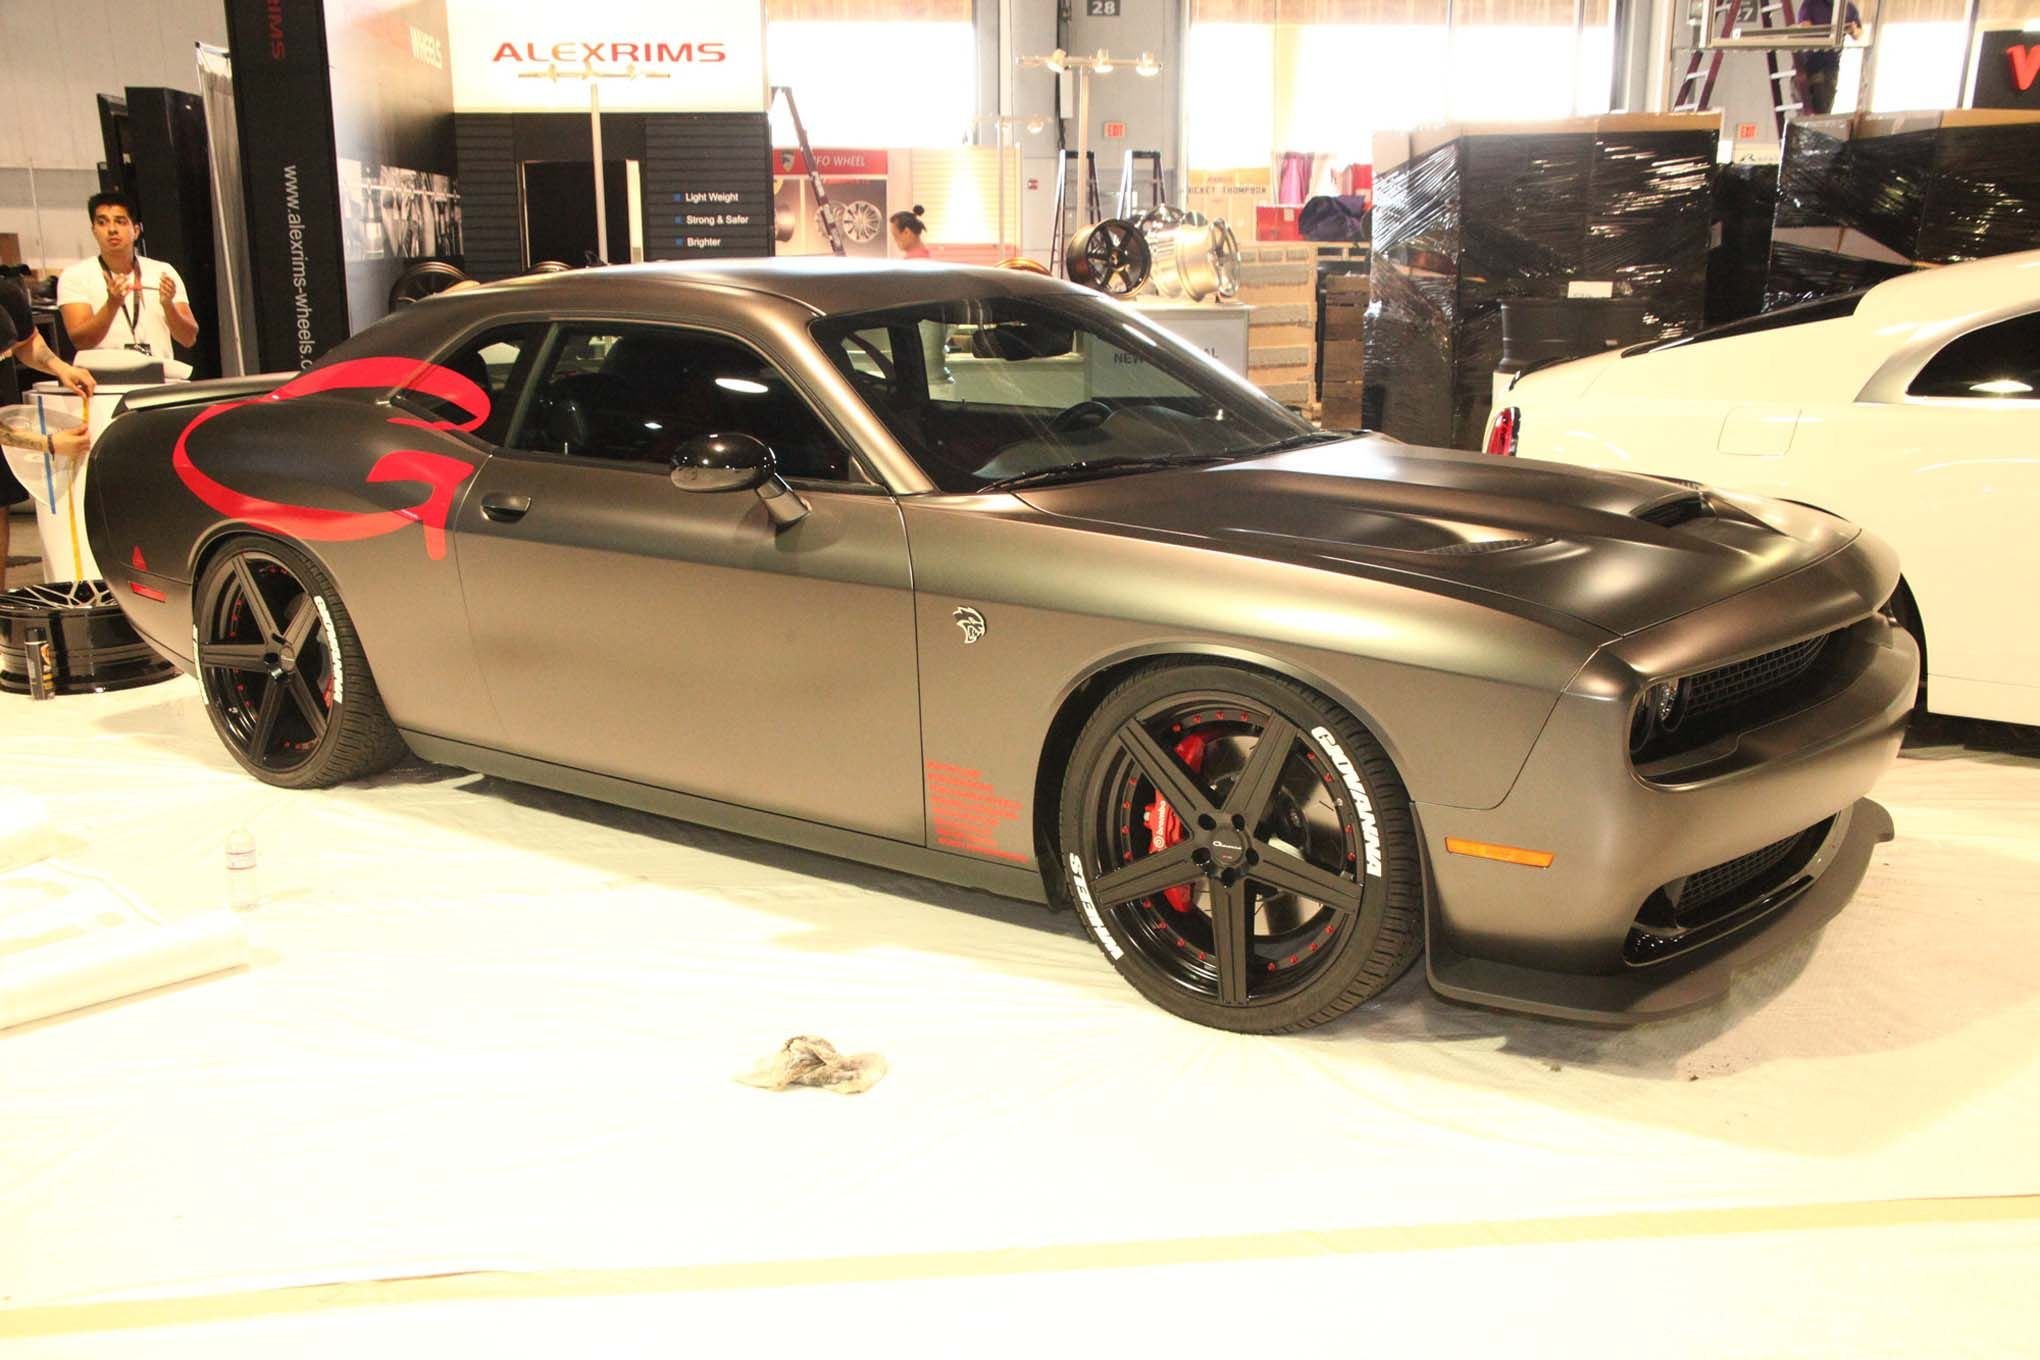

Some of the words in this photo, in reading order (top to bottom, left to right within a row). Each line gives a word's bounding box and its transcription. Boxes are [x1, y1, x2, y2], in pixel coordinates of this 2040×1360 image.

[1091, 0, 1116, 15] 28
[493, 42, 727, 62] ALEXRIMS
[833, 155, 865, 167] WHEEL
[685, 192, 707, 203] Light
[708, 192, 739, 204] Weight
[686, 215, 715, 226] Strong
[717, 215, 724, 224] &
[726, 215, 749, 224] Safer
[687, 237, 721, 248] Brighter
[1311, 726, 1382, 878] GIOVANNA
